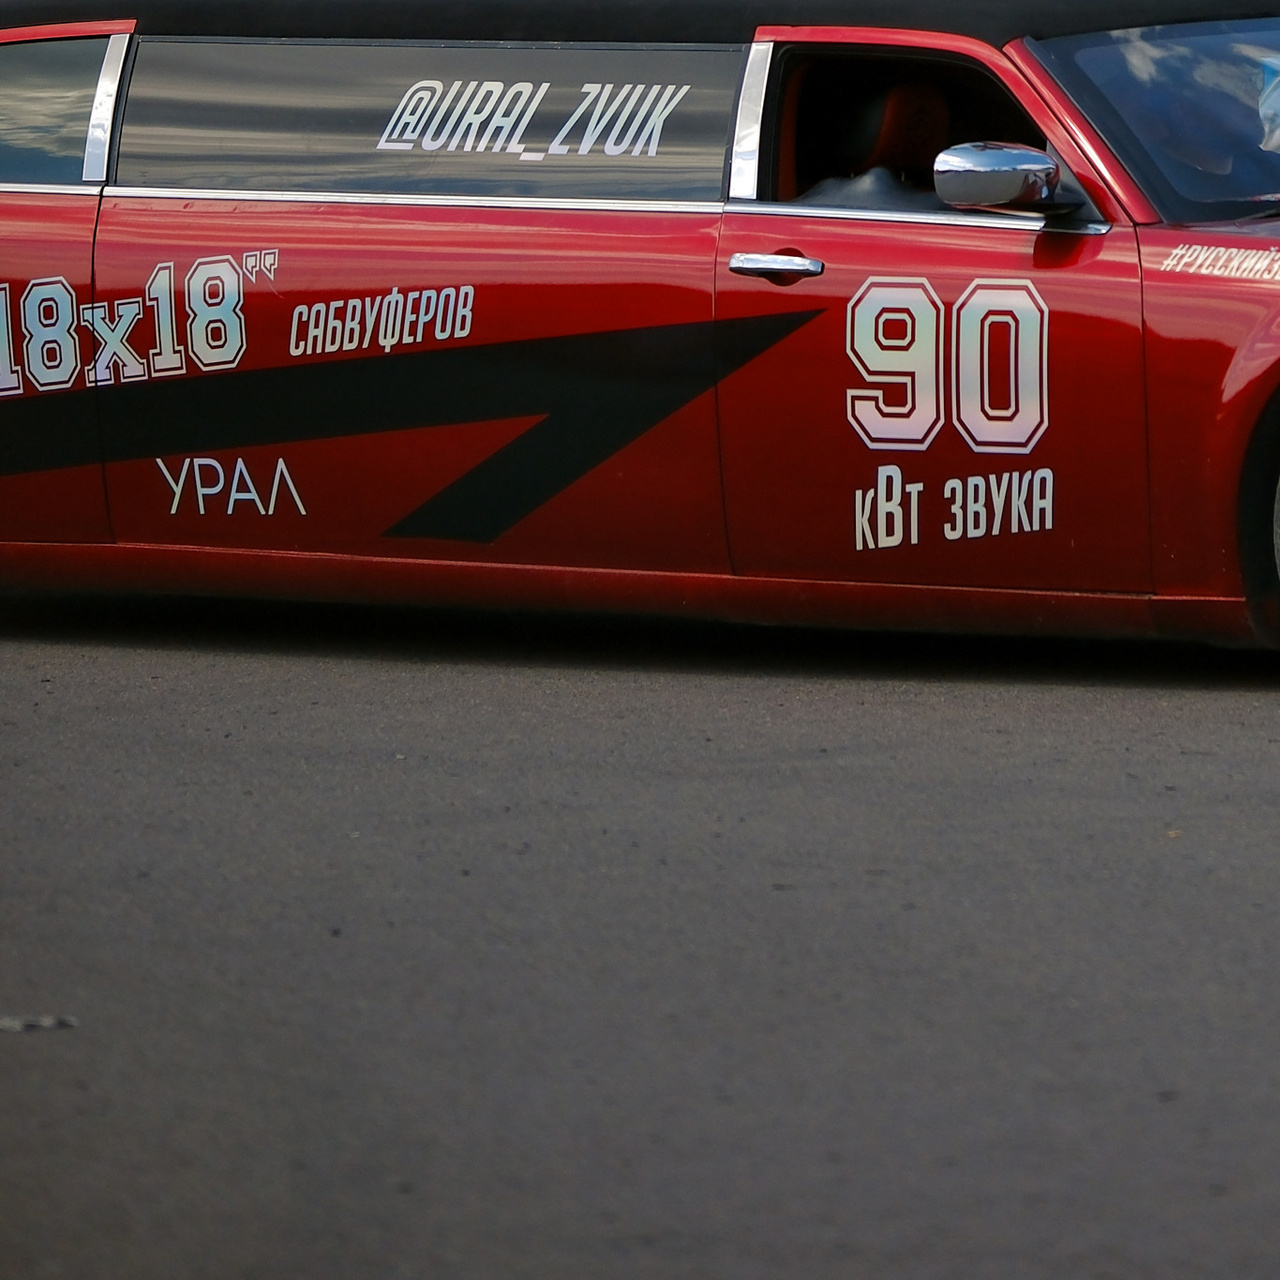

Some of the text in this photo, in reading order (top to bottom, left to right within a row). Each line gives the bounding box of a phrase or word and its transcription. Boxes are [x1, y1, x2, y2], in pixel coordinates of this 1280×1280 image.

[377, 80, 690, 161] @URAL_ZVUK
[289, 285, 475, 357] САБВУФЕРОВ
[846, 276, 1050, 455] 90
[155, 457, 307, 516] УРАЛ
[943, 468, 1054, 541] ЗВУКА
